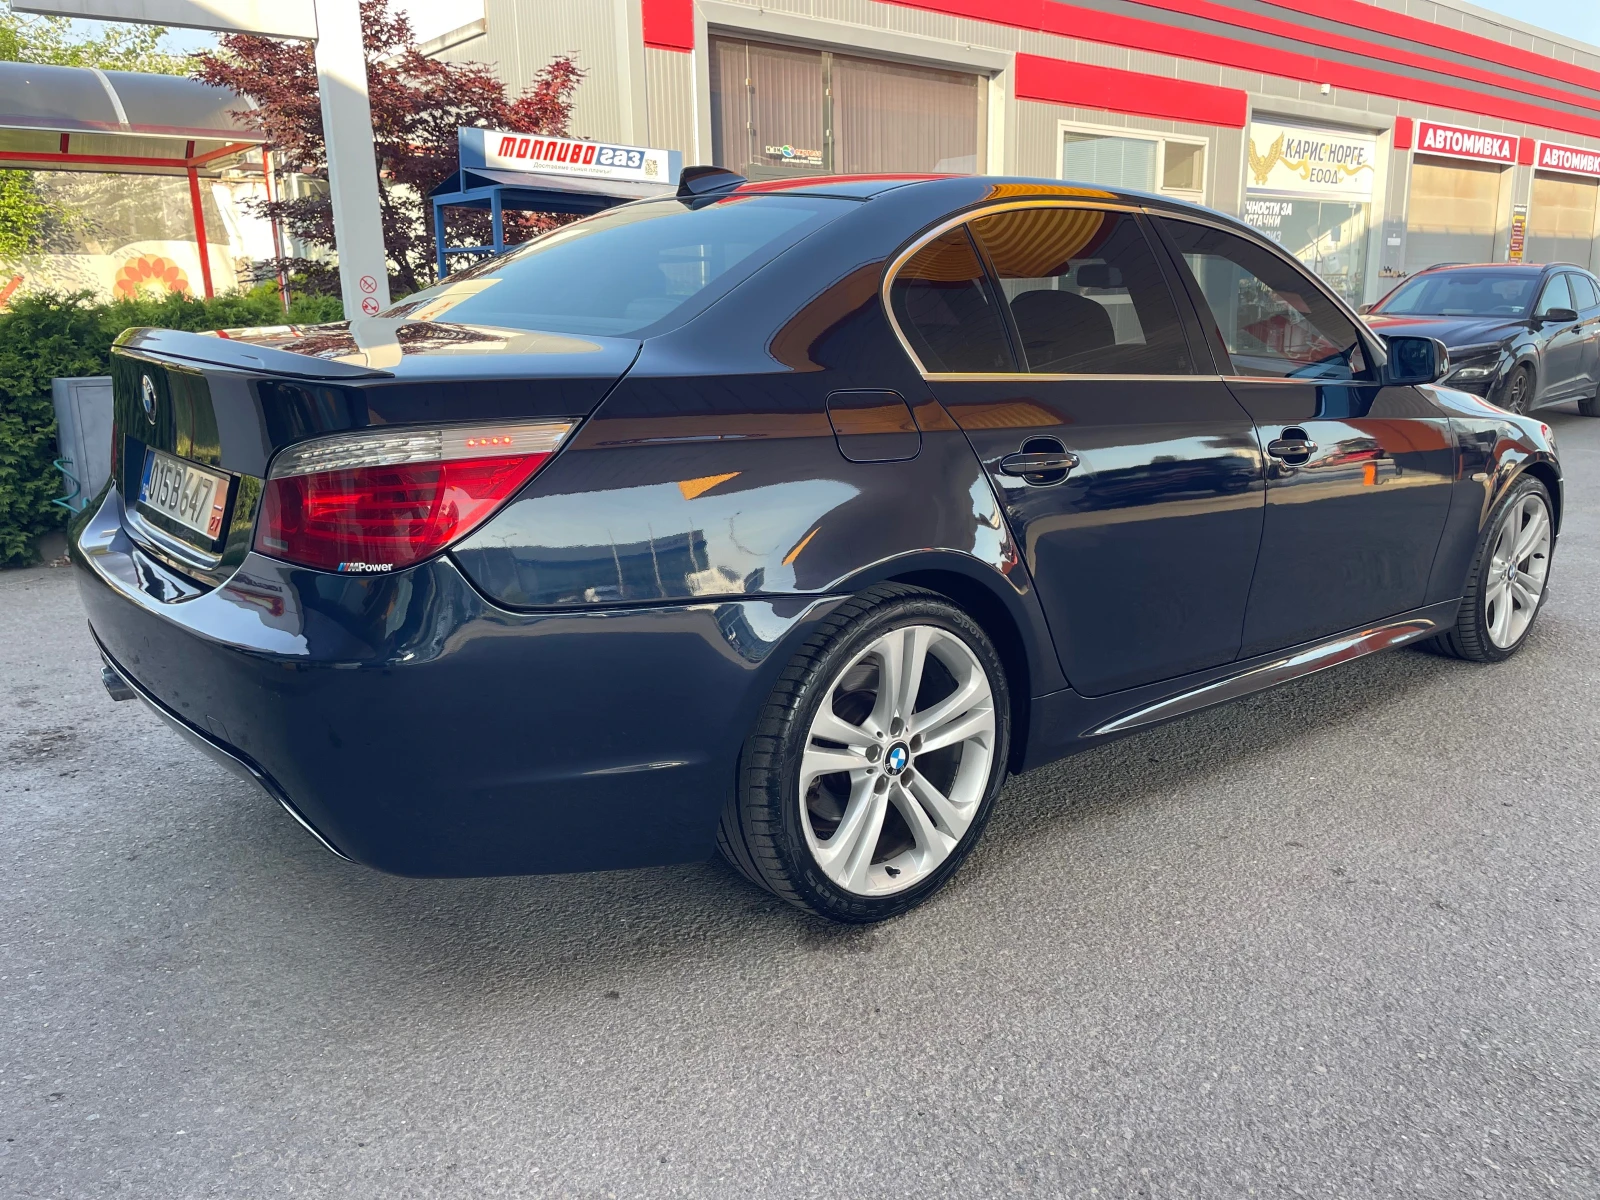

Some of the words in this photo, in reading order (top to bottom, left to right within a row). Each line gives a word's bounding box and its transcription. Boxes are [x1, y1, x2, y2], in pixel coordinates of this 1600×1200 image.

[1284, 138, 1326, 162] КАРИС
[1328, 143, 1365, 166] НОРГЕ
[1423, 128, 1511, 158] АВТОМИВКА
[1309, 168, 1338, 184] ЕООД
[1245, 201, 1280, 215] ЧНОСТИ
[1281, 202, 1293, 216] ЗА
